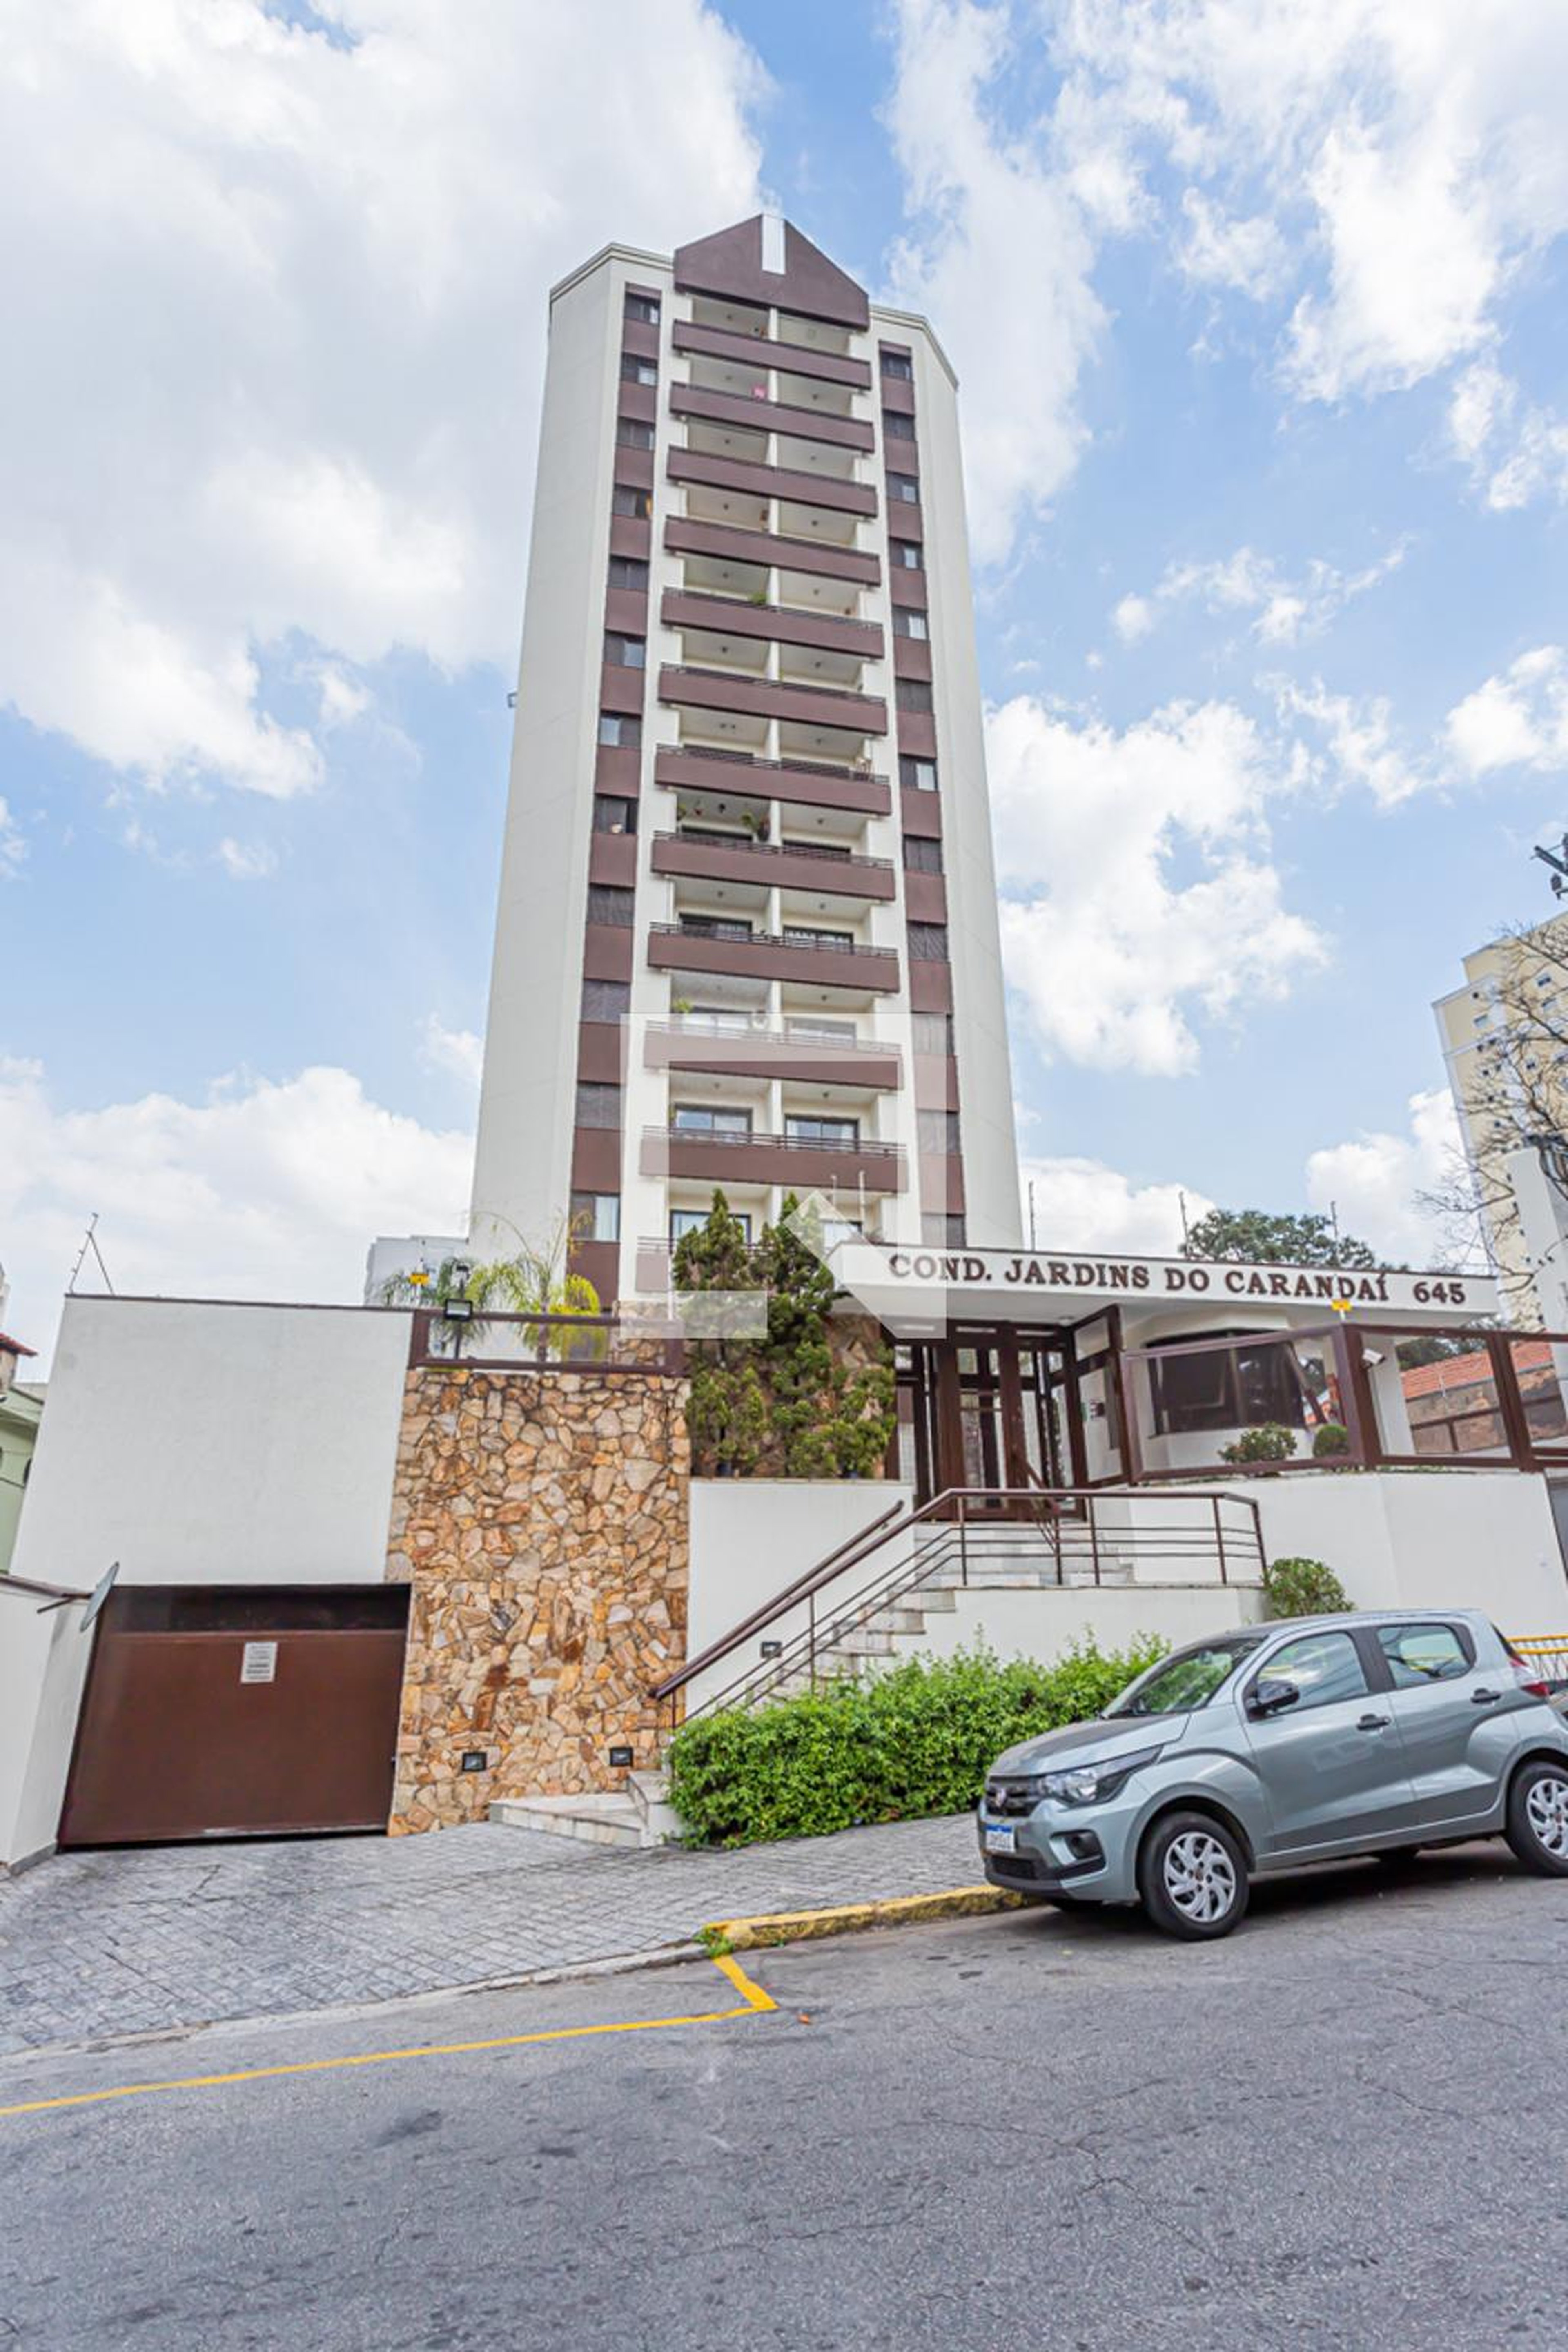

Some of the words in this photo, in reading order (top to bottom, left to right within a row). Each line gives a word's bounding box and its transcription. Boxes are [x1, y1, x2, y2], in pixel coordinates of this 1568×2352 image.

[889, 1254, 992, 1281] COND.
[1004, 1259, 1150, 1289] JARDINS
[1164, 1267, 1210, 1292] DO
[1225, 1270, 1389, 1301] CARANDAÍ
[1413, 1281, 1466, 1304] 645
